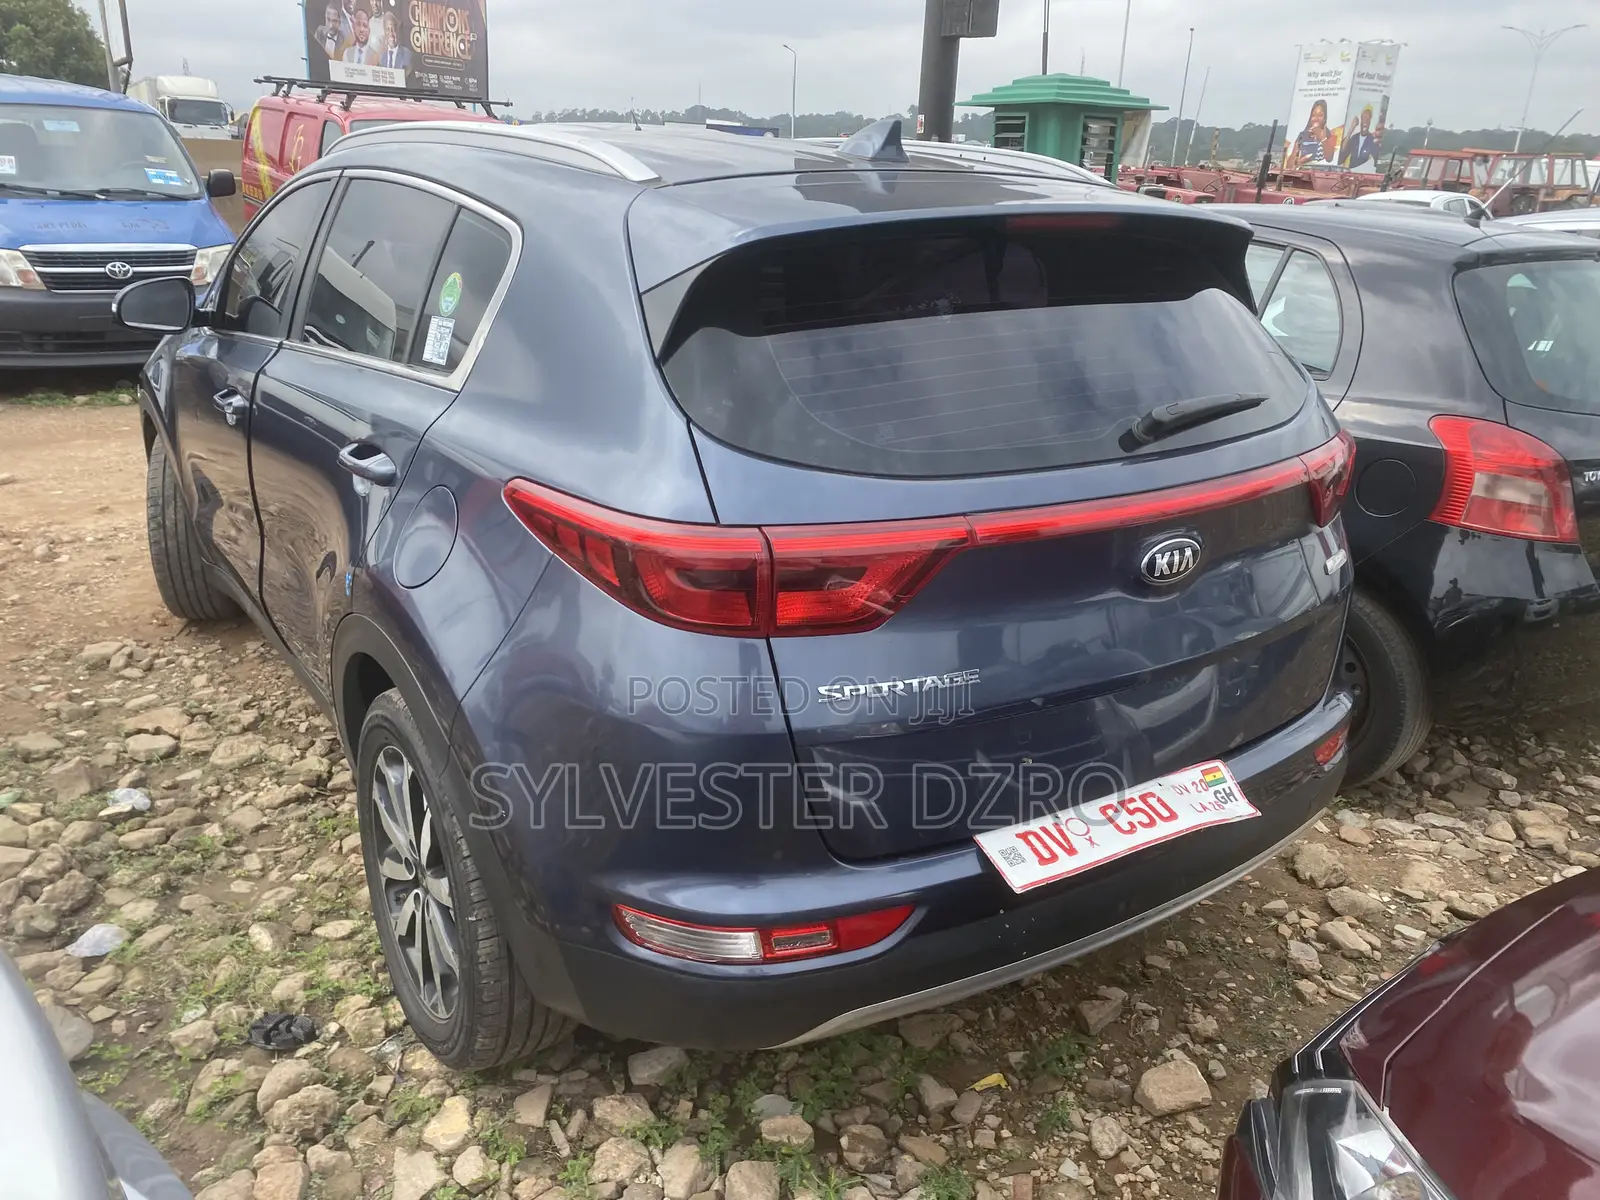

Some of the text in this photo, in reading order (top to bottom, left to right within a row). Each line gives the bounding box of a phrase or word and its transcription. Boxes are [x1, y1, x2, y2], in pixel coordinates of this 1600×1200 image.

[409, 0, 471, 34] CHAMPIONS
[410, 26, 472, 60] CONFERENCE
[1307, 78, 1341, 86] month-end?
[1334, 70, 1342, 78] for
[1365, 72, 1376, 80] Paid
[1154, 546, 1194, 577] KIA
[817, 668, 982, 703] SPORTAGE
[1213, 786, 1239, 806] GH
[1015, 821, 1079, 867] DV
